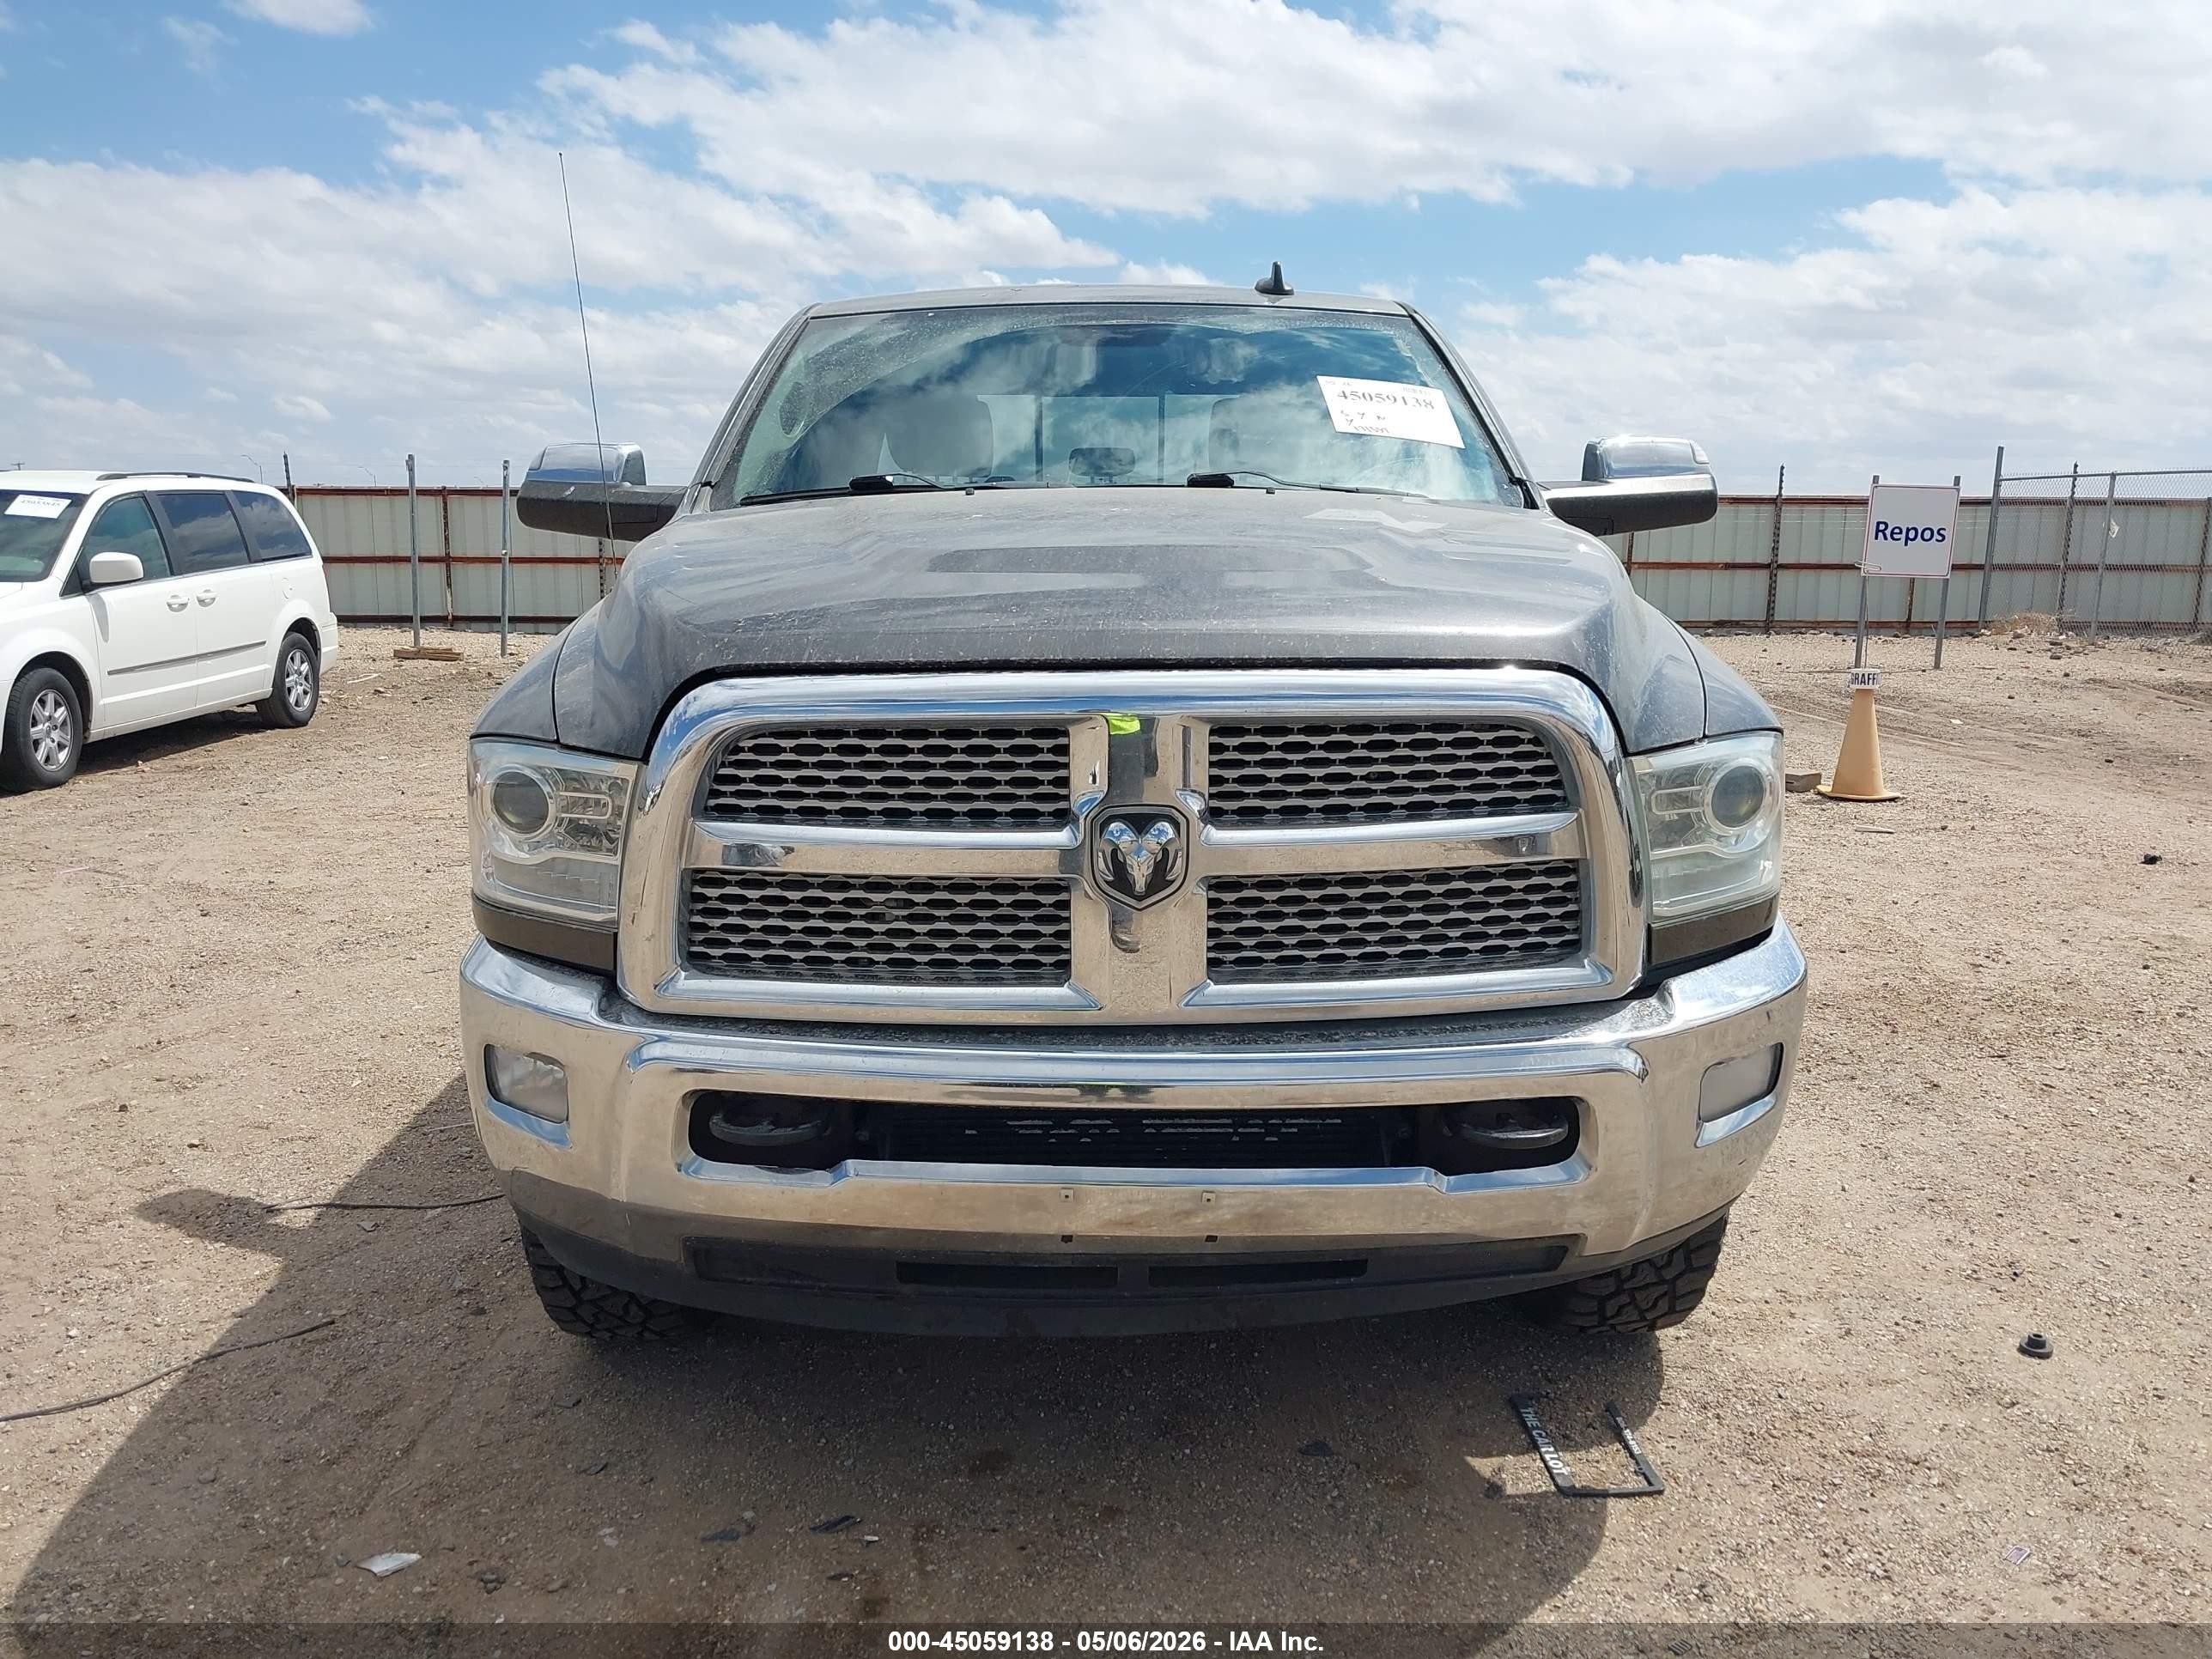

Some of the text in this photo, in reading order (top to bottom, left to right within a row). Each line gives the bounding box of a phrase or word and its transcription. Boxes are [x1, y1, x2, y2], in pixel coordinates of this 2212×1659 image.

[1337, 389, 1435, 410] 45059138
[1874, 520, 1947, 547] Repos
[1520, 1407, 1569, 1475] THE CAR LOT
